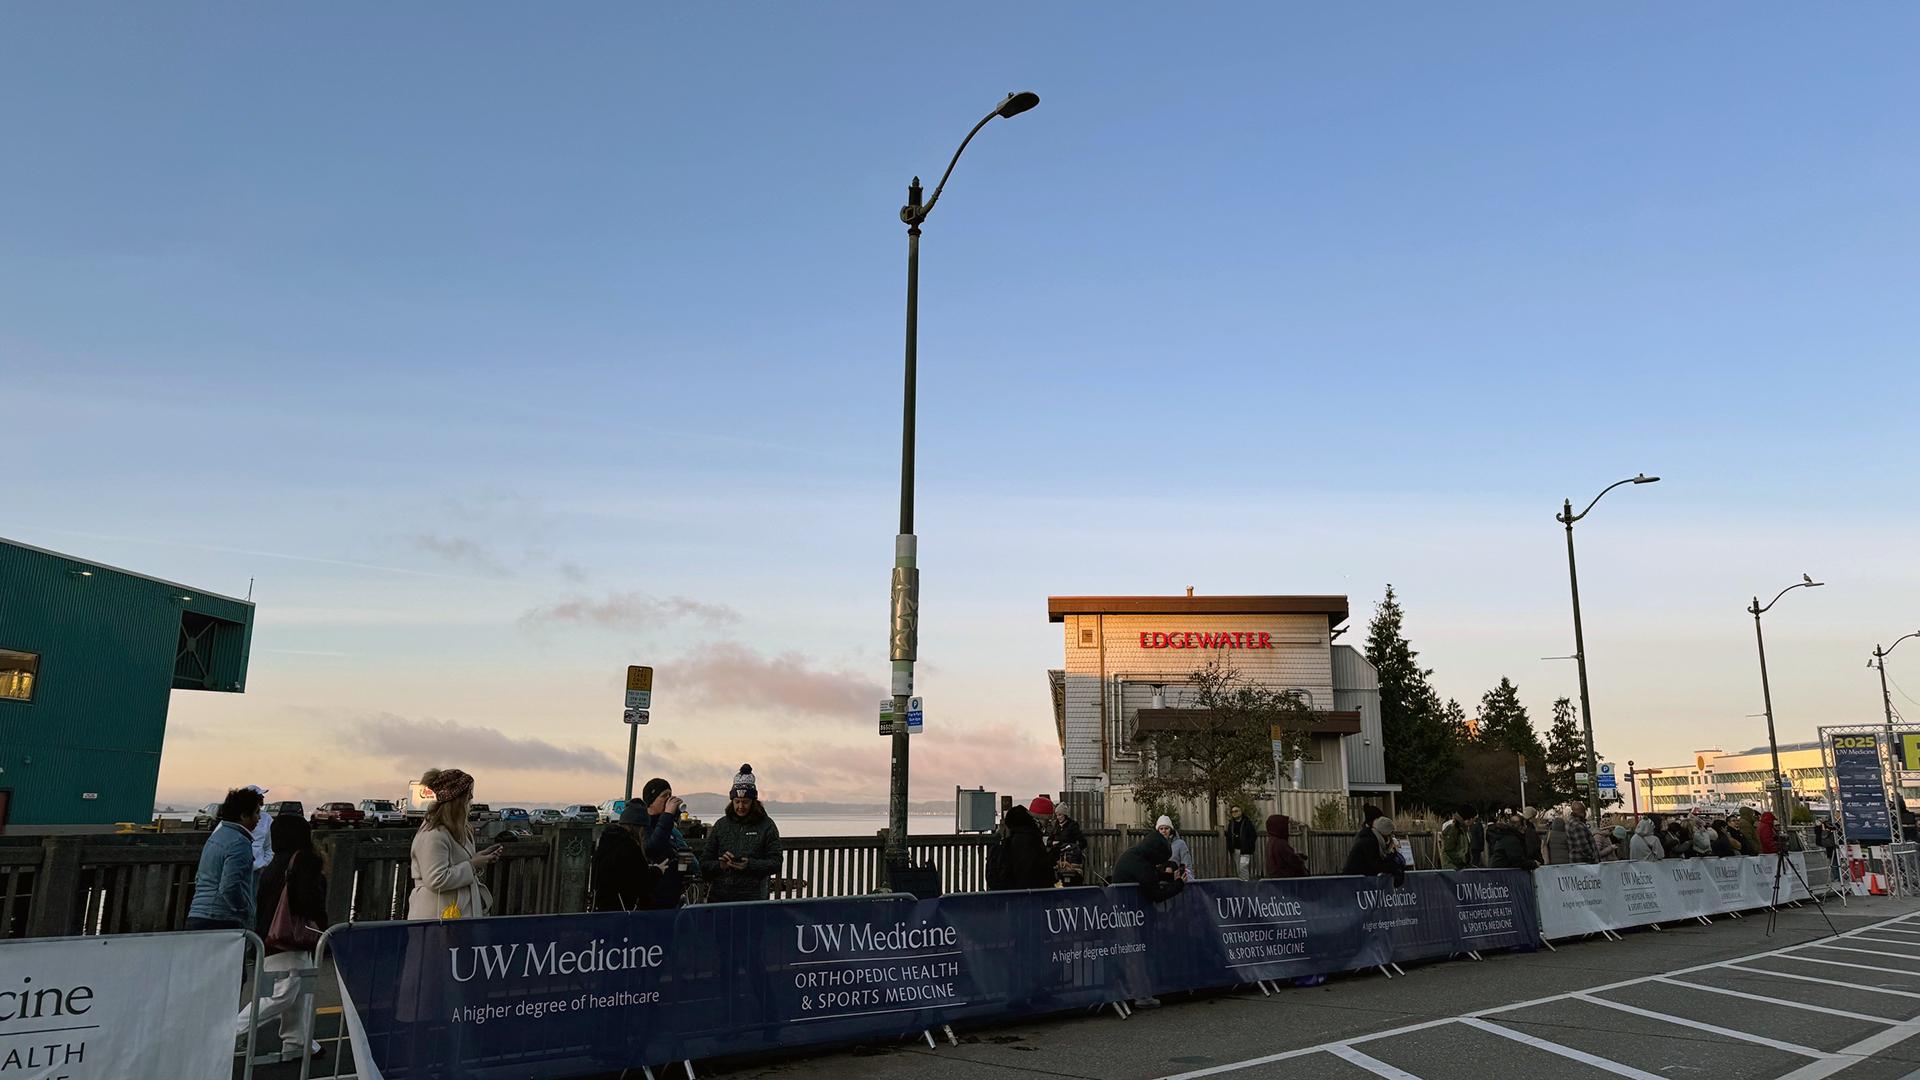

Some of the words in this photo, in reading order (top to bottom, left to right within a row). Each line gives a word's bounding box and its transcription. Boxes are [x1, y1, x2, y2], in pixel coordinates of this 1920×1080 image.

[1140, 631, 1273, 649] EDGEWATER
[1834, 736, 1876, 748] 2025
[1356, 889, 1378, 910] UW
[1378, 888, 1417, 909] Medicine
[1456, 883, 1474, 901] UW
[1474, 882, 1510, 899] Medicine
[1045, 906, 1080, 934] UW
[1082, 903, 1145, 931] Medicine
[1216, 896, 1245, 919] UW
[1247, 896, 1302, 918] Medicine
[1458, 908, 1492, 921] ORTHOPEDIC
[1493, 907, 1512, 917] HEALTH
[796, 923, 845, 953] UW
[850, 920, 957, 951] Medicine
[1222, 929, 1274, 945] ORTHOPEDIC
[1276, 927, 1308, 940] HEALTH
[1468, 921, 1488, 932] SPORTS
[1488, 919, 1513, 930] MEDICINE
[449, 943, 519, 982] UW
[522, 937, 663, 977] Medicine
[1052, 951, 1058, 963] A
[1059, 948, 1082, 964] higher
[1083, 946, 1109, 960] degree
[1110, 943, 1118, 955] of
[1118, 942, 1146, 954] healthcare
[1228, 949, 1235, 960] &
[1235, 945, 1265, 959] SPORTS
[1266, 942, 1305, 957] MEDICINE
[795, 967, 898, 989] ORTHOPEDIC
[901, 961, 959, 981] HEALTH
[451, 1007, 461, 1023] A
[464, 1003, 511, 1025] higher
[515, 1000, 567, 1018] degree
[571, 995, 586, 1010] of
[589, 990, 660, 1008] healthcare
[801, 995, 812, 1010] &
[818, 989, 879, 1009] SPORTS
[885, 983, 956, 1003] MEDICINE
